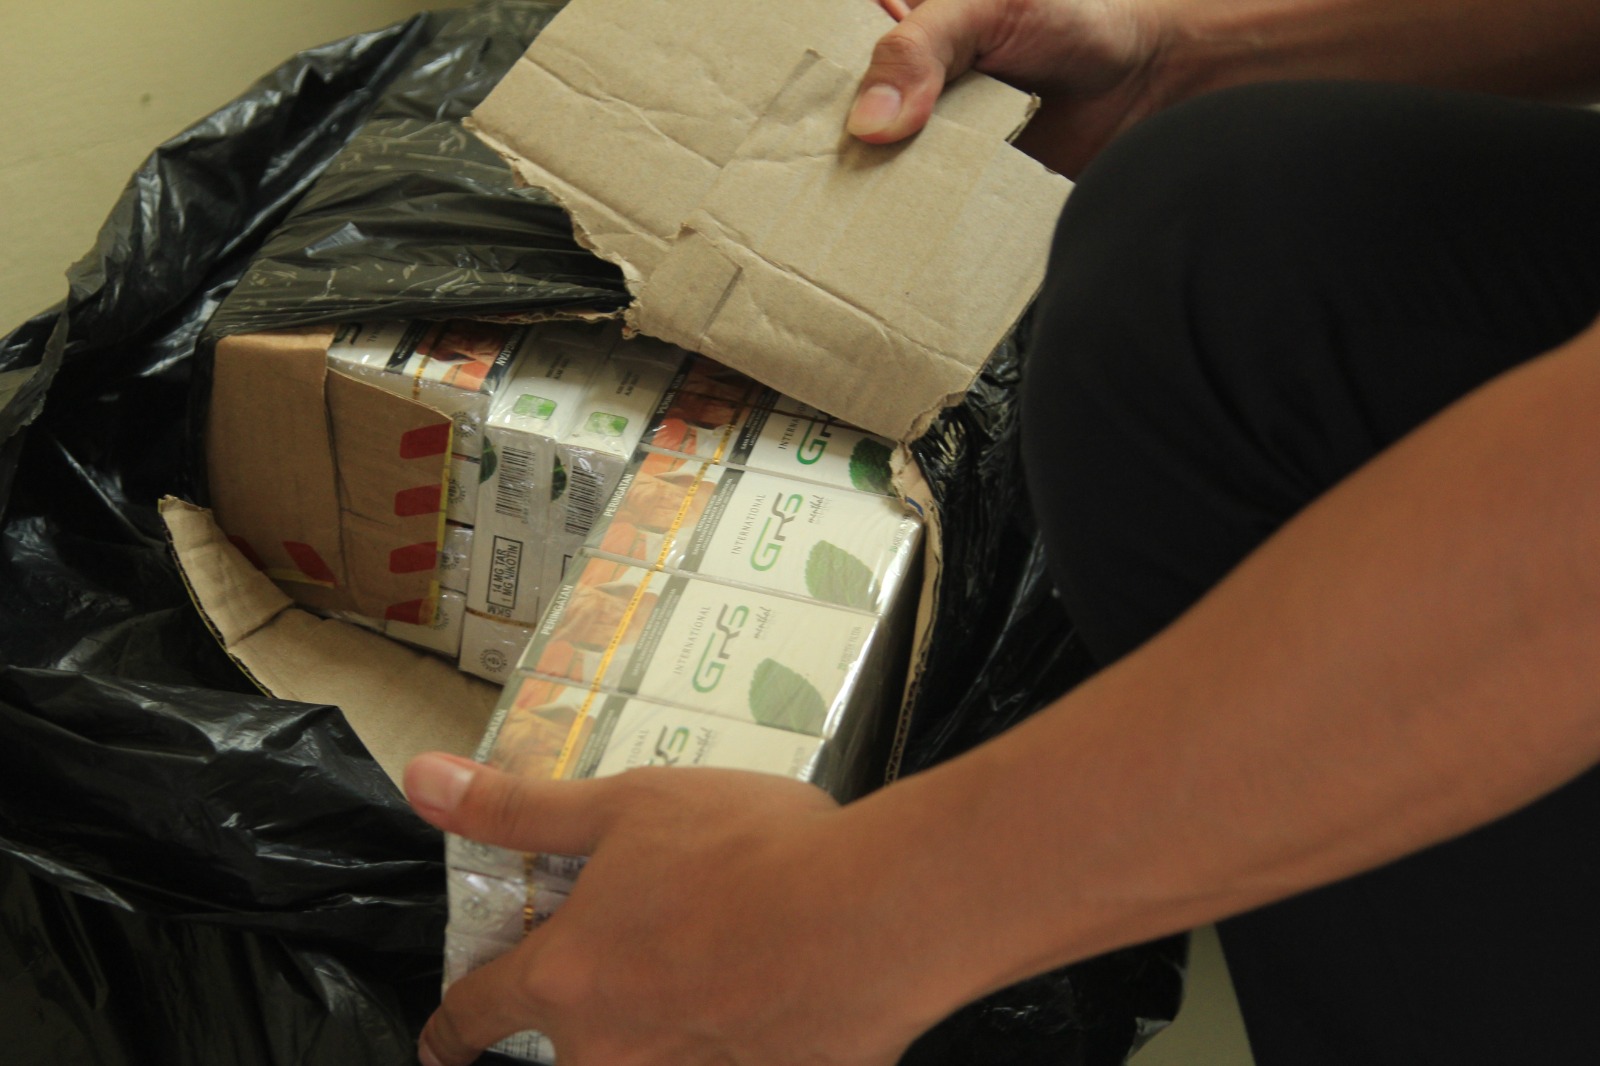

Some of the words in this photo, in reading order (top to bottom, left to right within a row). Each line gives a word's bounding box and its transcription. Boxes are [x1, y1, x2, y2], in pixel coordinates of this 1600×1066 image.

[604, 474, 634, 517] PERINGATAN
[808, 494, 824, 524] menthol
[732, 494, 766, 554] INTERNATIONAL
[750, 492, 803, 572] GRS
[494, 568, 504, 584] MG
[496, 549, 507, 567] TAR
[505, 544, 519, 581] NIKOTIN
[492, 584, 502, 594] 14
[502, 582, 514, 598] MG
[541, 584, 574, 635] PERINGATAN
[754, 606, 771, 639] menthol
[673, 606, 711, 674] INTERNATIONAL
[692, 604, 750, 693] GRS
[474, 709, 508, 763] ERINGATAN
[648, 726, 690, 766] RS
